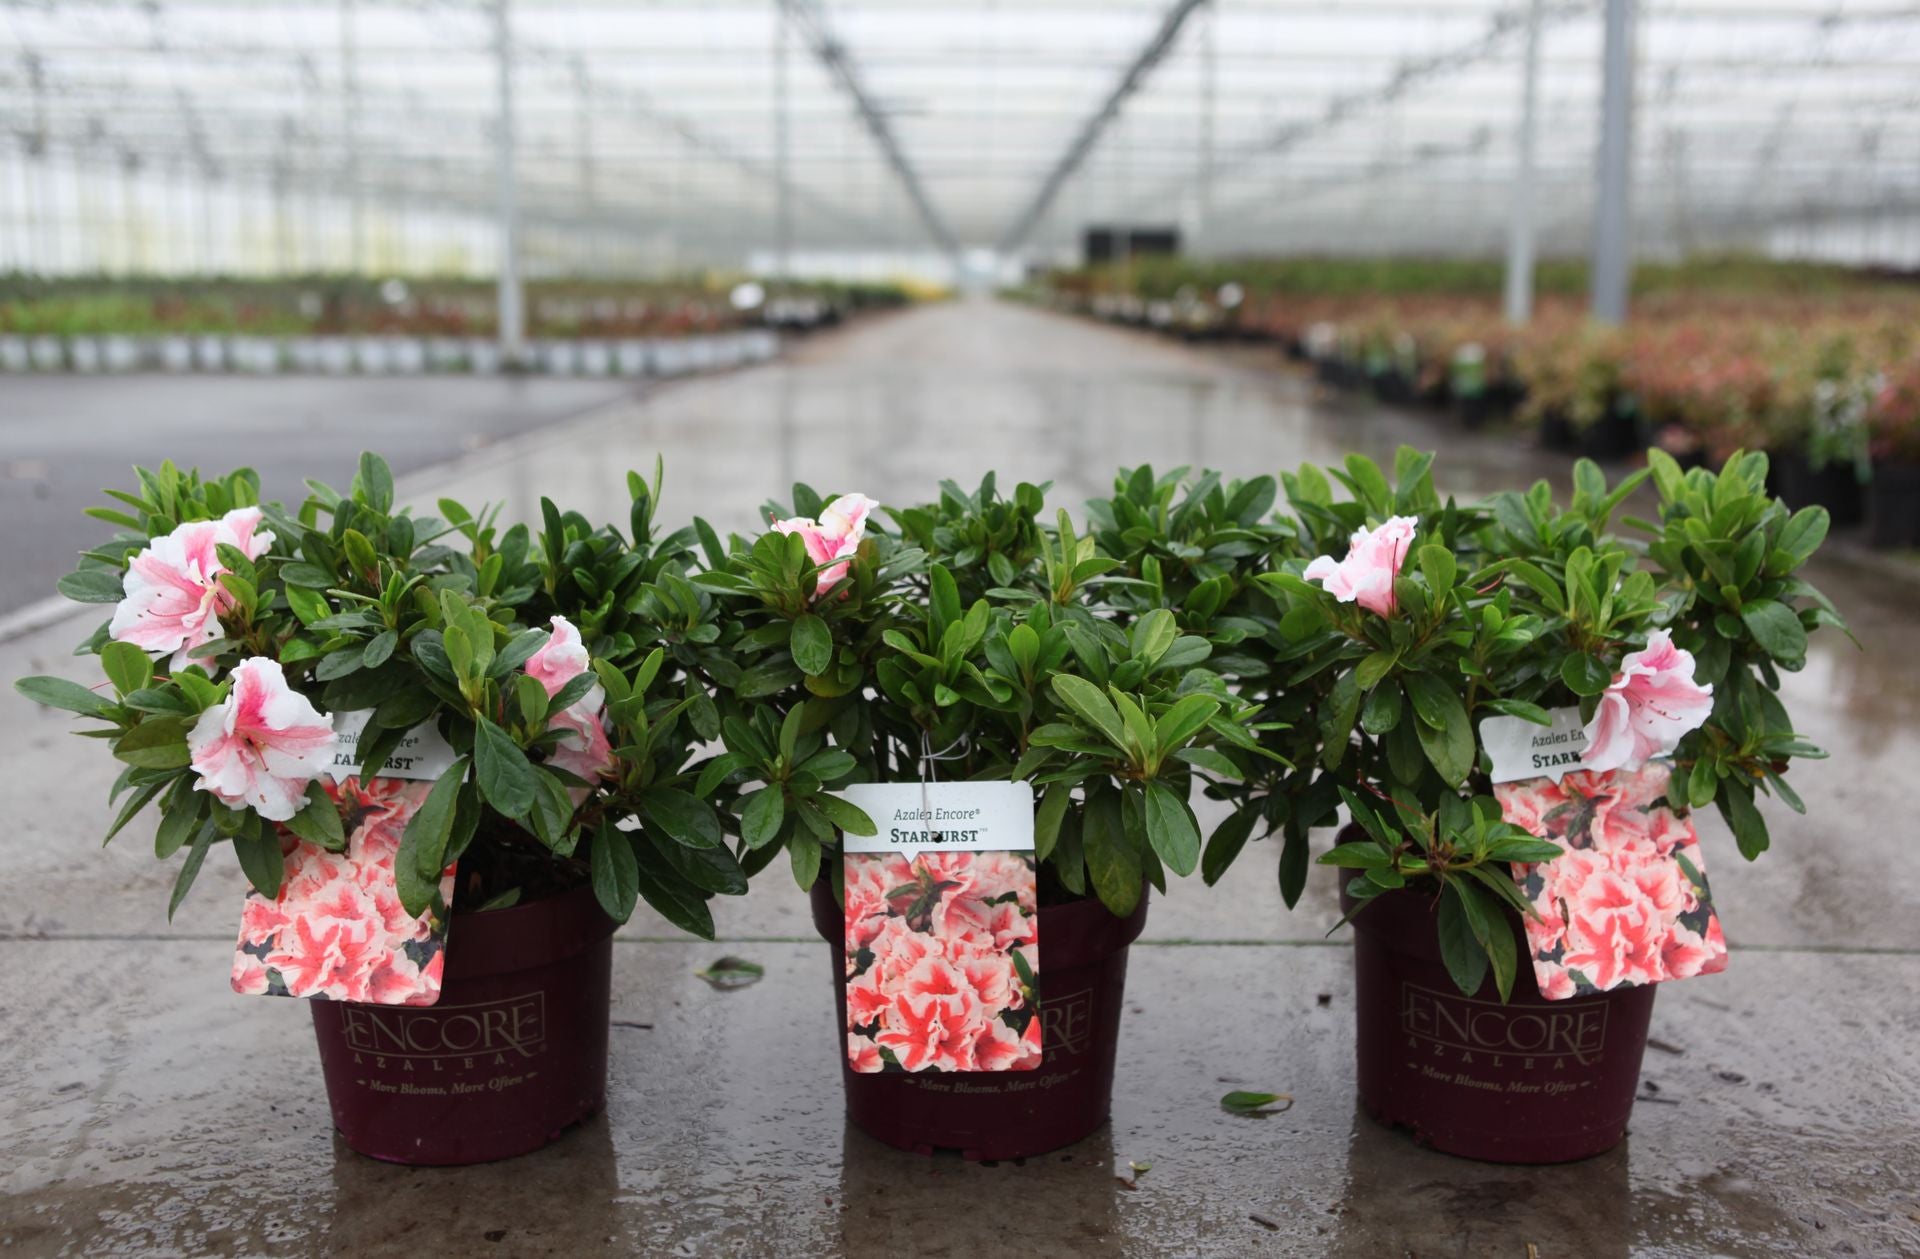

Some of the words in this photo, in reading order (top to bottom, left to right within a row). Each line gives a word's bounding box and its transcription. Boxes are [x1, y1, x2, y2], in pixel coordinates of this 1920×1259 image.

[1532, 732, 1568, 747] Azalea
[894, 808, 932, 820] Azalea
[345, 1001, 539, 1057] ENCORE
[1406, 992, 1601, 1065] ENCORE
[354, 1053, 505, 1071] AZALEA
[1408, 1037, 1565, 1069] AZALEA
[370, 1079, 398, 1093] More
[400, 1082, 447, 1096] Blooms,
[451, 1082, 485, 1095] More
[488, 1075, 524, 1091] Often
[919, 1078, 950, 1092] More
[1004, 1079, 1036, 1092] More
[1039, 1073, 1069, 1088] Often
[1421, 1064, 1451, 1081] More
[1454, 1073, 1503, 1092] Blooms,
[1507, 1081, 1541, 1093] More
[1544, 1080, 1577, 1096] Often
